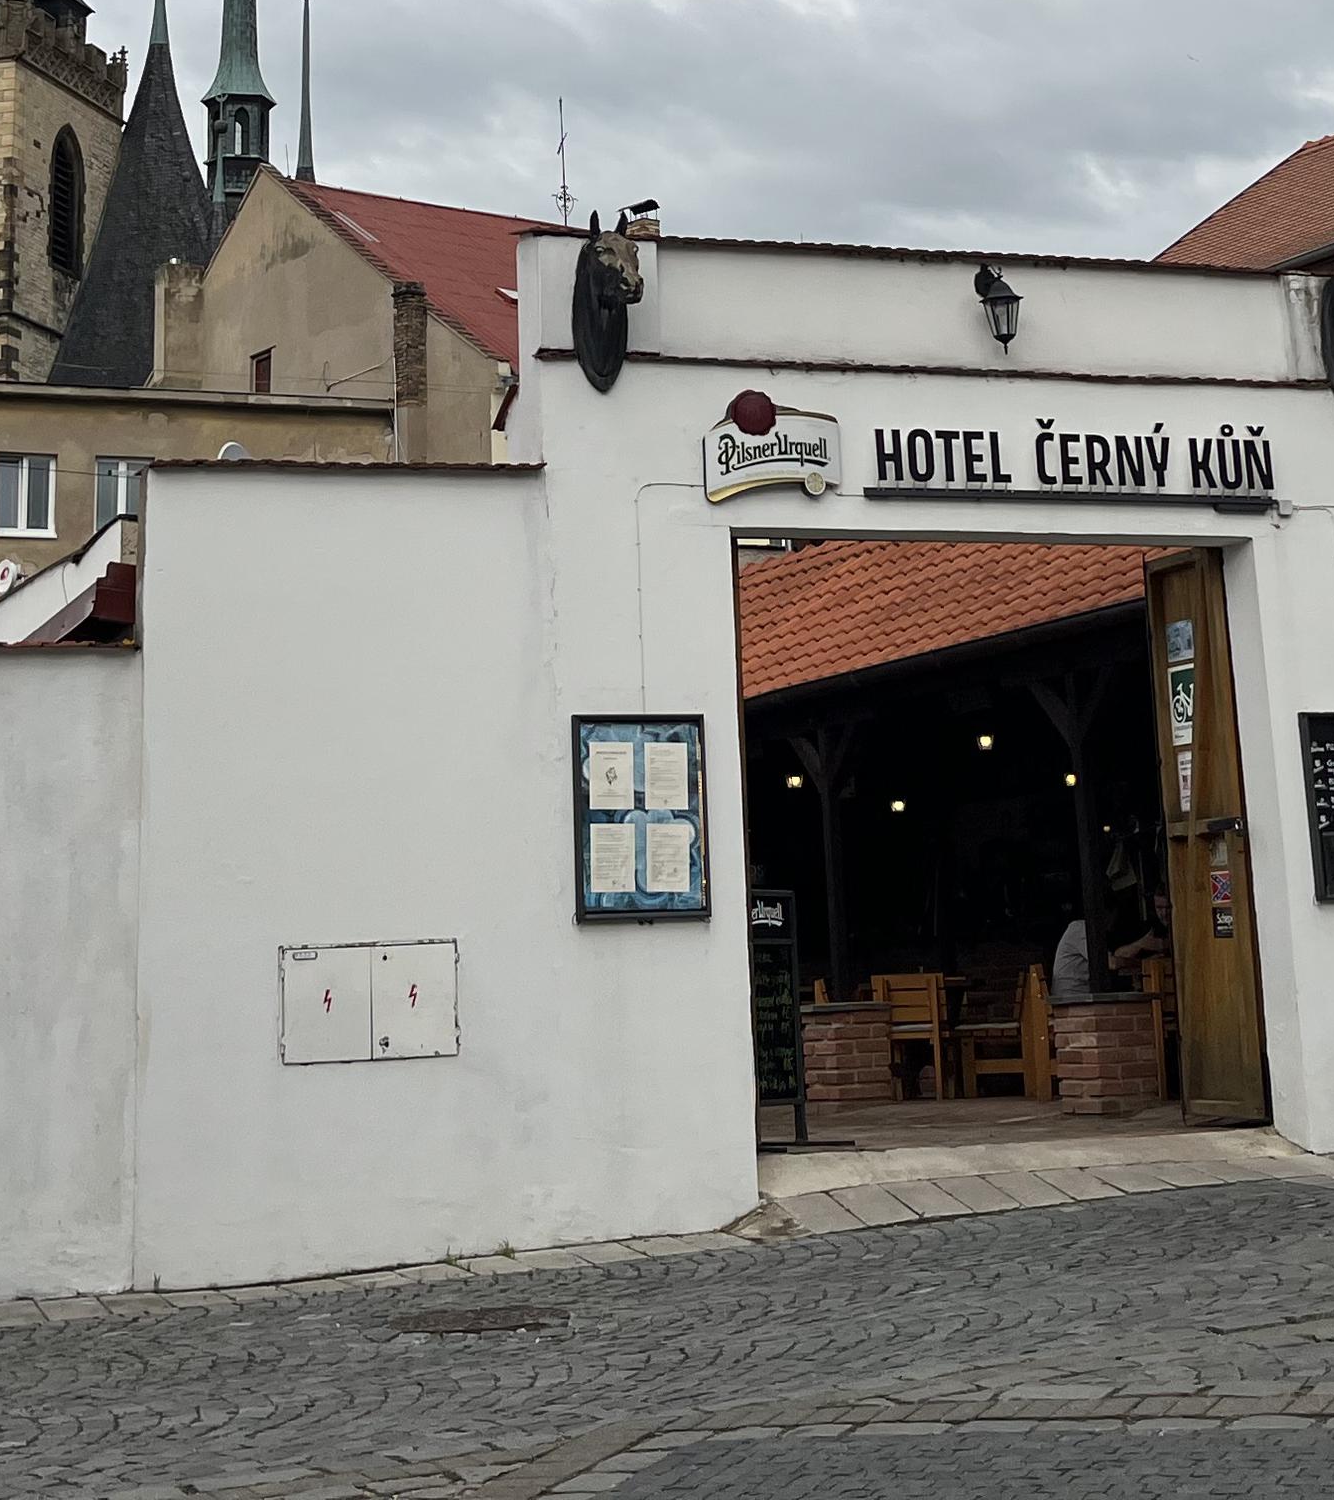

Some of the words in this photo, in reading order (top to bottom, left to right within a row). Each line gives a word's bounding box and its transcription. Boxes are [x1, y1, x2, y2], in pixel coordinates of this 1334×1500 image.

[717, 433, 776, 476] Pilsner
[775, 431, 829, 467] Urquell
[875, 429, 1011, 483] HOTEL
[1035, 418, 1170, 487] ČERNÝ
[1188, 424, 1274, 490] KŮŇ
